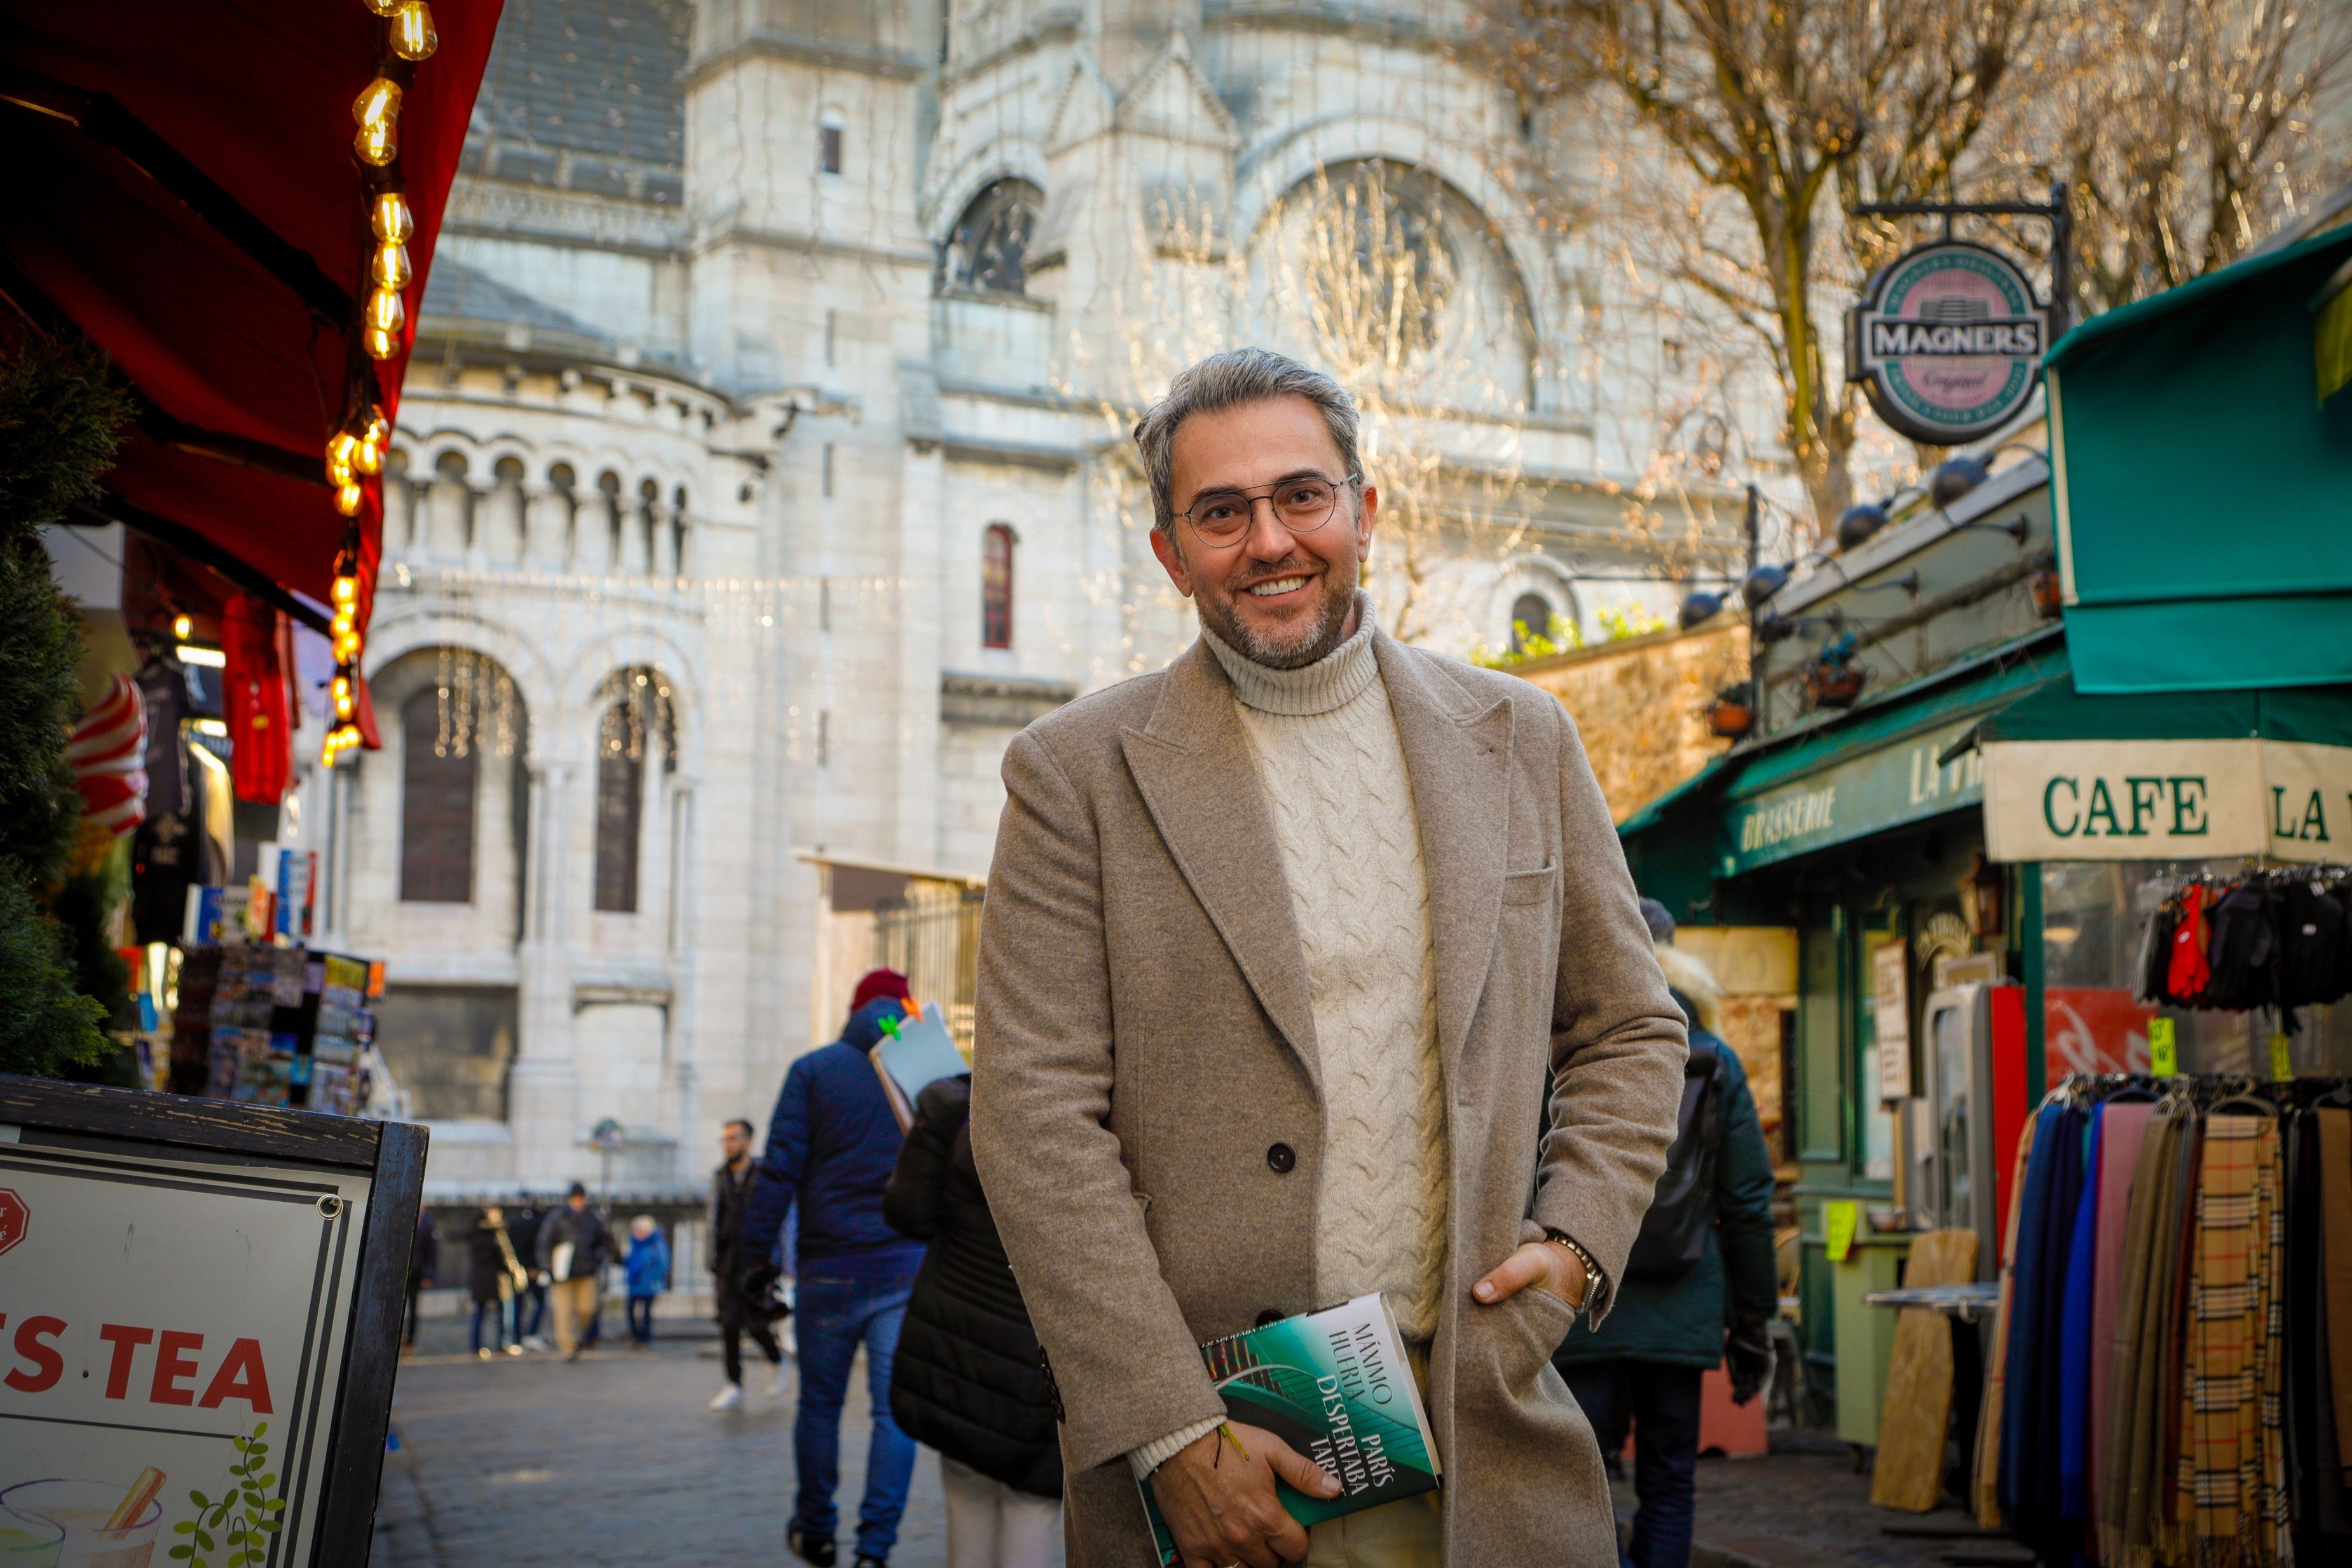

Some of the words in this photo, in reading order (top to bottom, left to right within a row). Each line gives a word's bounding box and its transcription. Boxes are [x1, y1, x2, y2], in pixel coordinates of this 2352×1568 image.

[1873, 322, 2038, 355] MAGNERS
[1739, 786, 1836, 853] BRASSERIE
[2042, 775, 2210, 838] CAFE
[2271, 785, 2332, 842] LA
[0, 1312, 69, 1393] S
[100, 1323, 274, 1415] TEA
[1329, 1330, 1366, 1401] HUERTA
[1353, 1323, 1393, 1406] MÁXIMO
[1316, 1374, 1370, 1496] DESPERTABA
[1360, 1433, 1395, 1488] PARÍS
